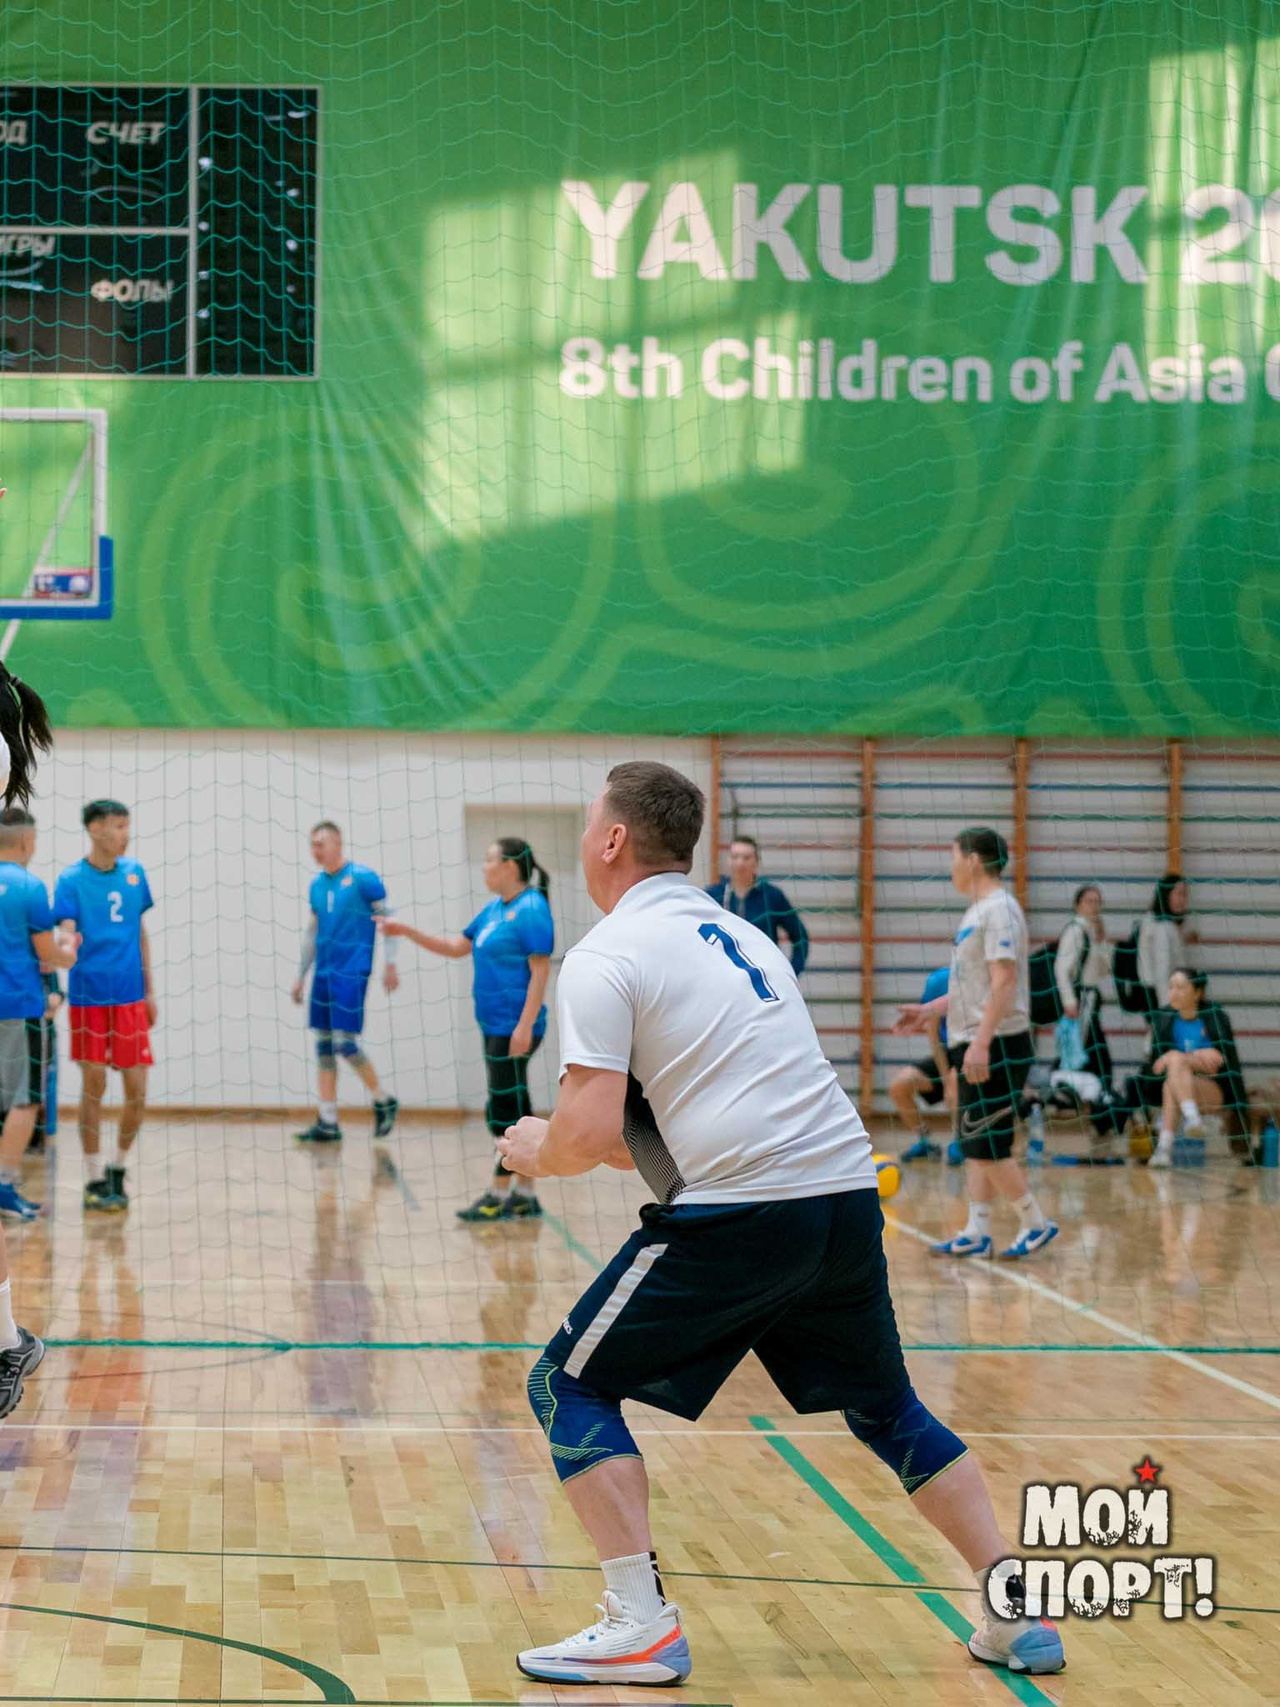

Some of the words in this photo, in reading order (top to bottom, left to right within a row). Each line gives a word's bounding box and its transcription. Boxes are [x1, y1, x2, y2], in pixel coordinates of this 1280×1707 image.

[86, 121, 168, 145] СЧЕТ
[560, 180, 1149, 287] YAKUTSK
[90, 279, 173, 301] ФОЛЫ
[559, 337, 683, 400] 8th
[701, 338, 994, 402] Children
[1005, 341, 1082, 403] of
[1094, 342, 1248, 404] Asia
[107, 891, 123, 922] 2
